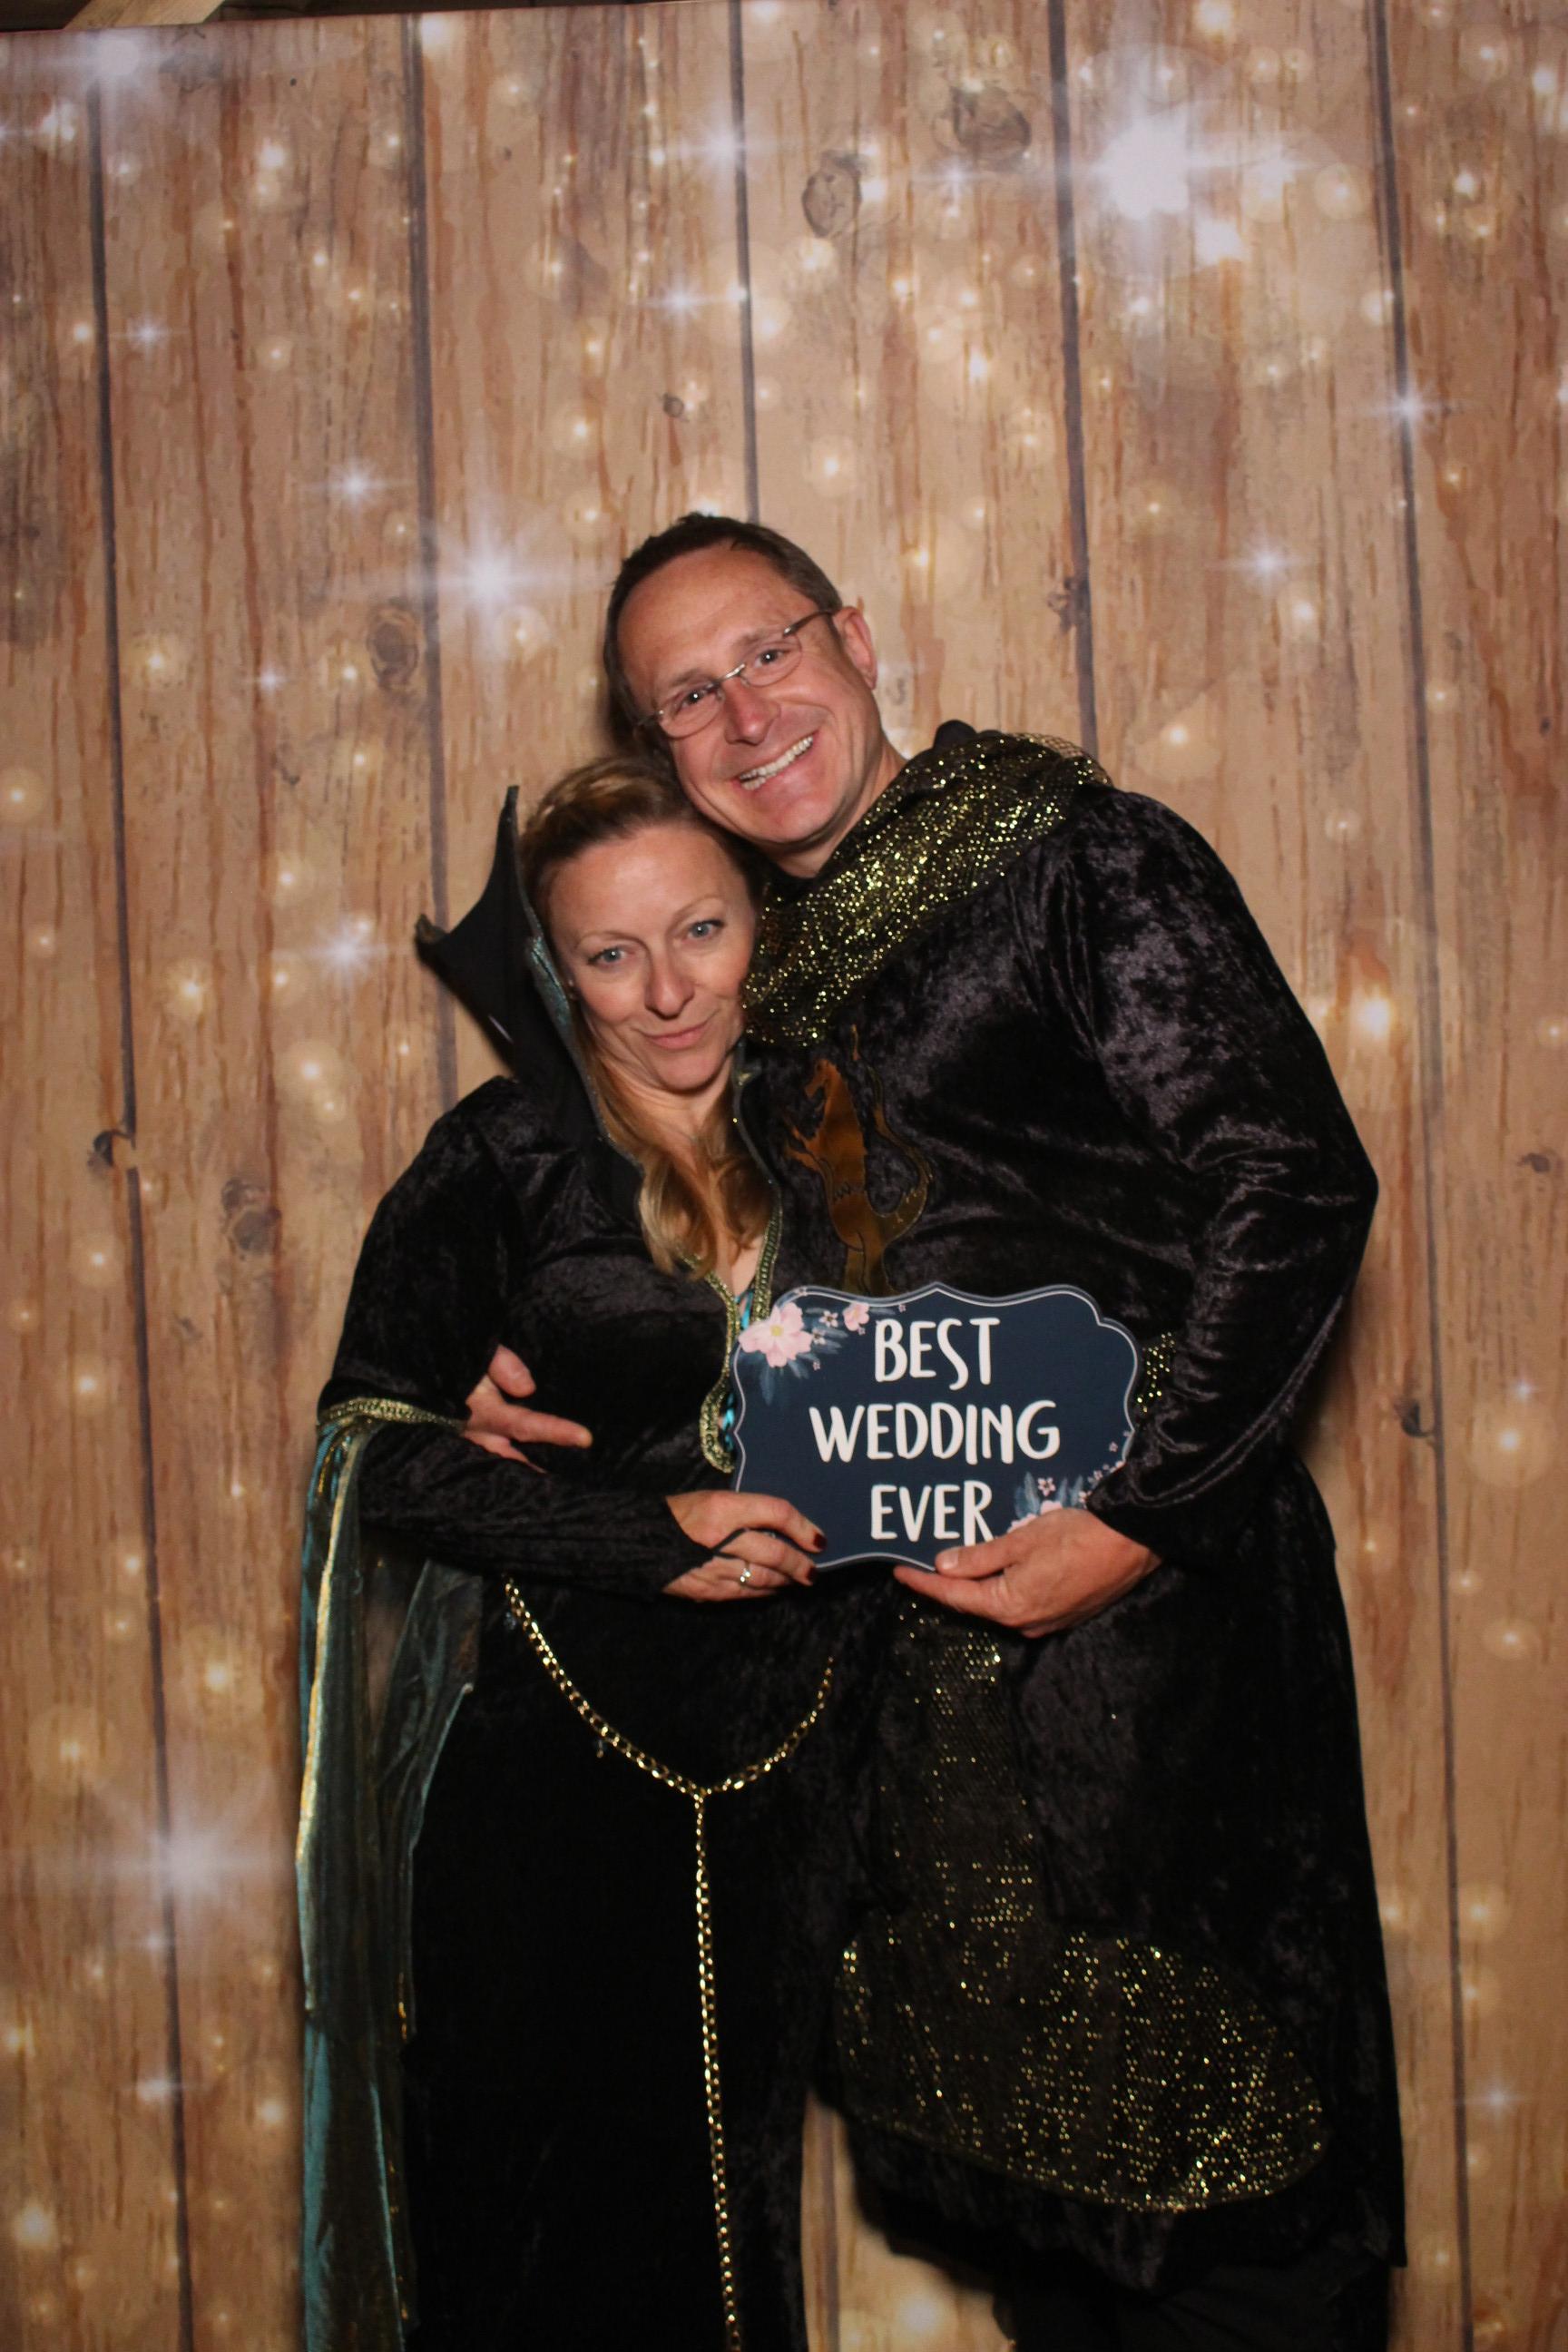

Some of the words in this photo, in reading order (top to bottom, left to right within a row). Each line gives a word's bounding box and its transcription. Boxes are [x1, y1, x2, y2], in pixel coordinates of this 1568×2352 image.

[874, 1318, 1000, 1390] BEST
[808, 1400, 1060, 1465] WEDDING
[870, 1480, 995, 1547] EVER
